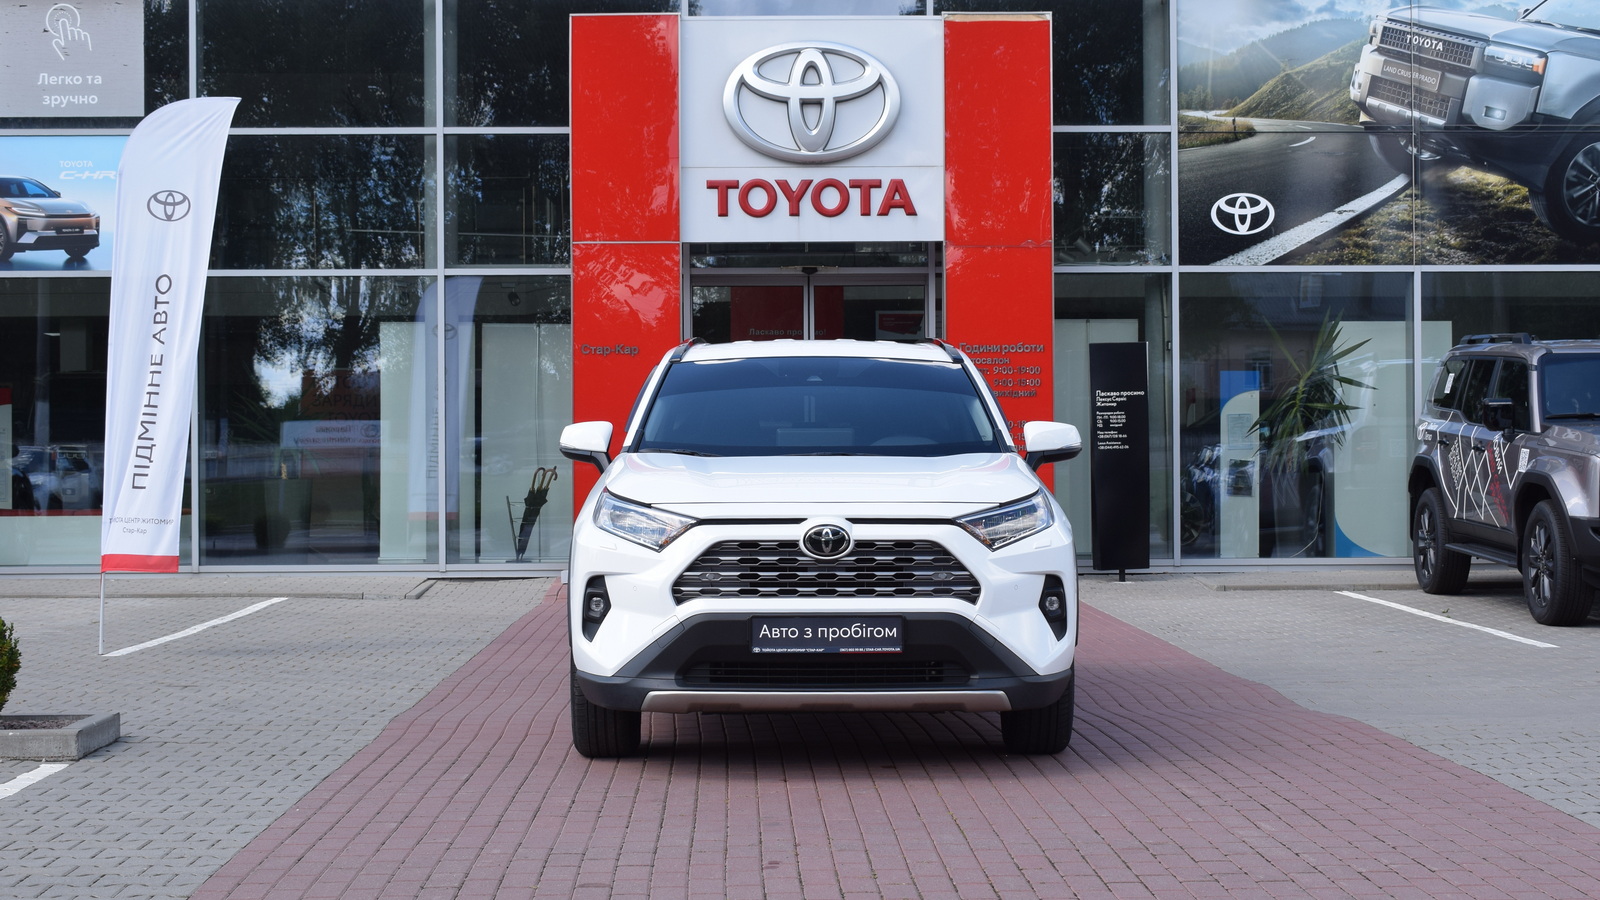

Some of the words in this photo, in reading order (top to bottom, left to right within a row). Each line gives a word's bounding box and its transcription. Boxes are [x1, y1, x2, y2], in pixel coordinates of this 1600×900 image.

[1406, 35, 1443, 51] TOYOTA
[38, 73, 82, 85] Легко
[86, 75, 102, 85] та
[1383, 65, 1397, 74] LAND
[1397, 69, 1419, 79] CRUISER
[1419, 74, 1437, 84] PRADO
[42, 95, 98, 107] зручно
[59, 160, 94, 168] TOYOTA
[706, 178, 918, 218] TOYOTA
[581, 344, 639, 357] Стар-Кар
[959, 342, 1000, 354] Години
[1002, 342, 1045, 355] роботи
[993, 366, 1041, 375] 9:00-19:00
[131, 354, 164, 490] ПІДМІННЕ
[152, 273, 172, 345] АВТО
[994, 378, 1041, 387] 9:00-15:00
[122, 526, 148, 535] Стар-Кар
[759, 624, 799, 639] Авто
[803, 627, 813, 639] з
[818, 623, 897, 642] пробігом
